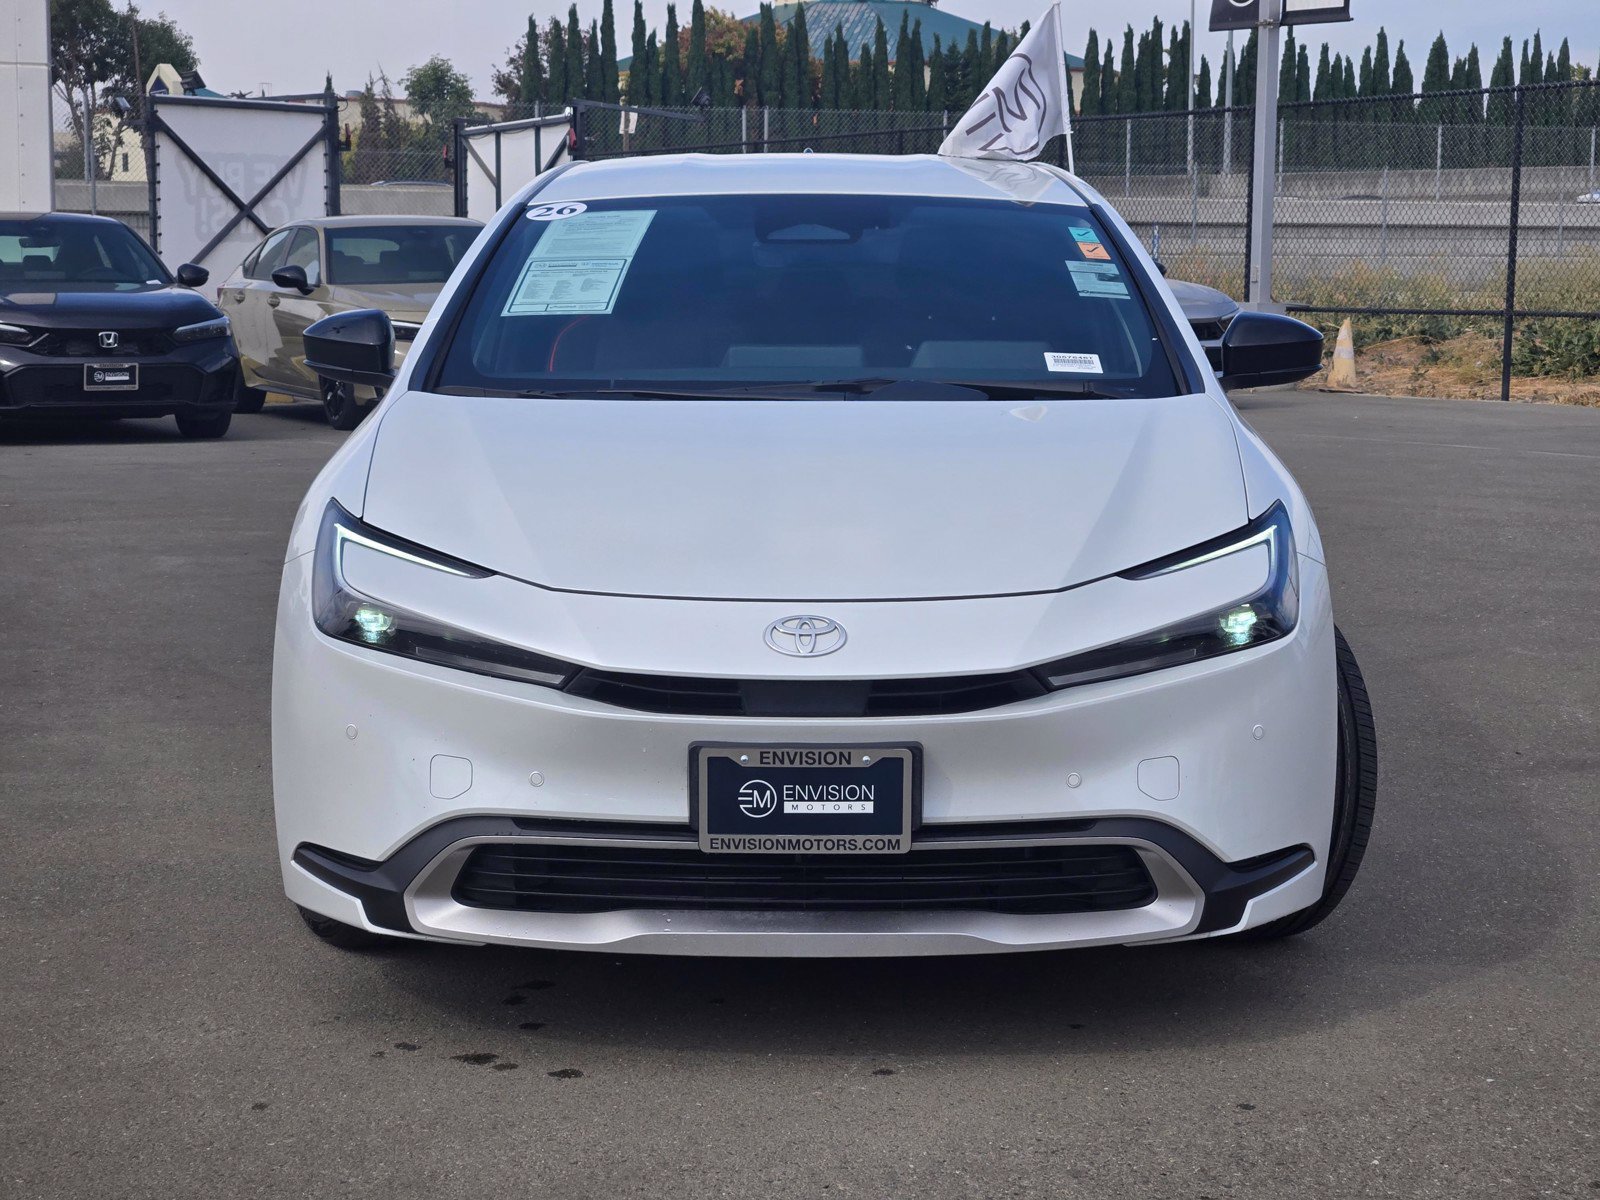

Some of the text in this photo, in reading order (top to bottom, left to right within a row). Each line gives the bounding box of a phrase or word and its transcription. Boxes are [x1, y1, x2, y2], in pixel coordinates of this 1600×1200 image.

[533, 205, 577, 218] 26
[759, 750, 852, 766] ENVISION
[783, 784, 875, 801] ENVISION
[791, 803, 867, 811] MOTORS
[709, 837, 901, 851] ENVISIONMOTORS.COM
